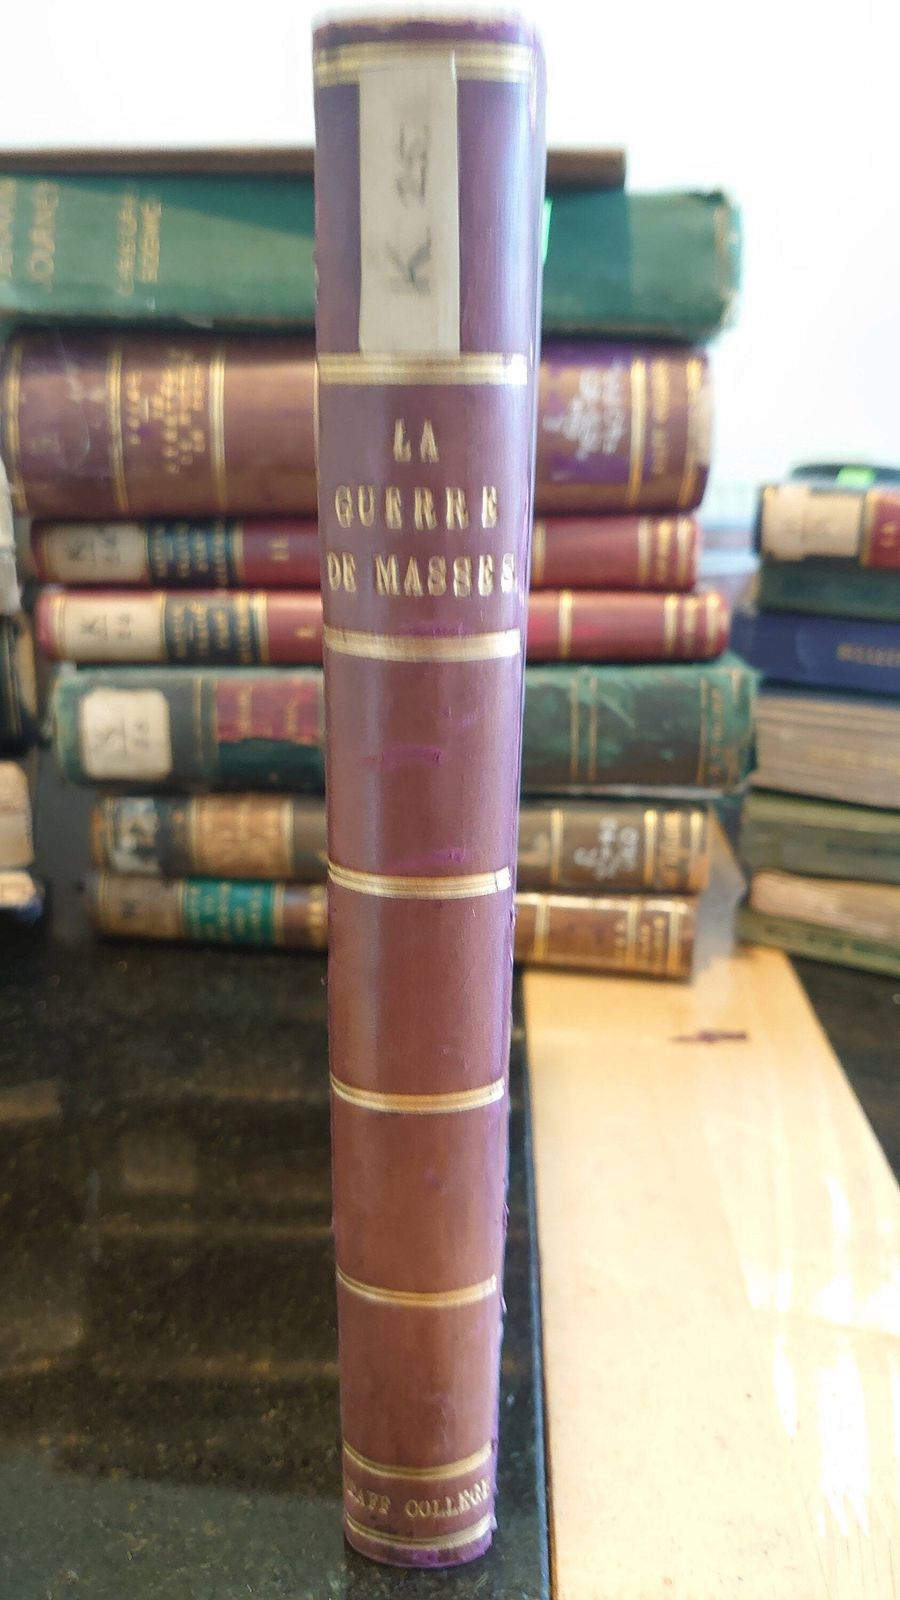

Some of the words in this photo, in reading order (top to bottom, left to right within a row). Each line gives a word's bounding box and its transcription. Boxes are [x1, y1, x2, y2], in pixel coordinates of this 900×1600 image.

[385, 224, 432, 296] K
[393, 418, 439, 463] LA
[335, 484, 498, 531] GUERRE
[326, 551, 357, 594] DE
[374, 552, 517, 598] MASSES
